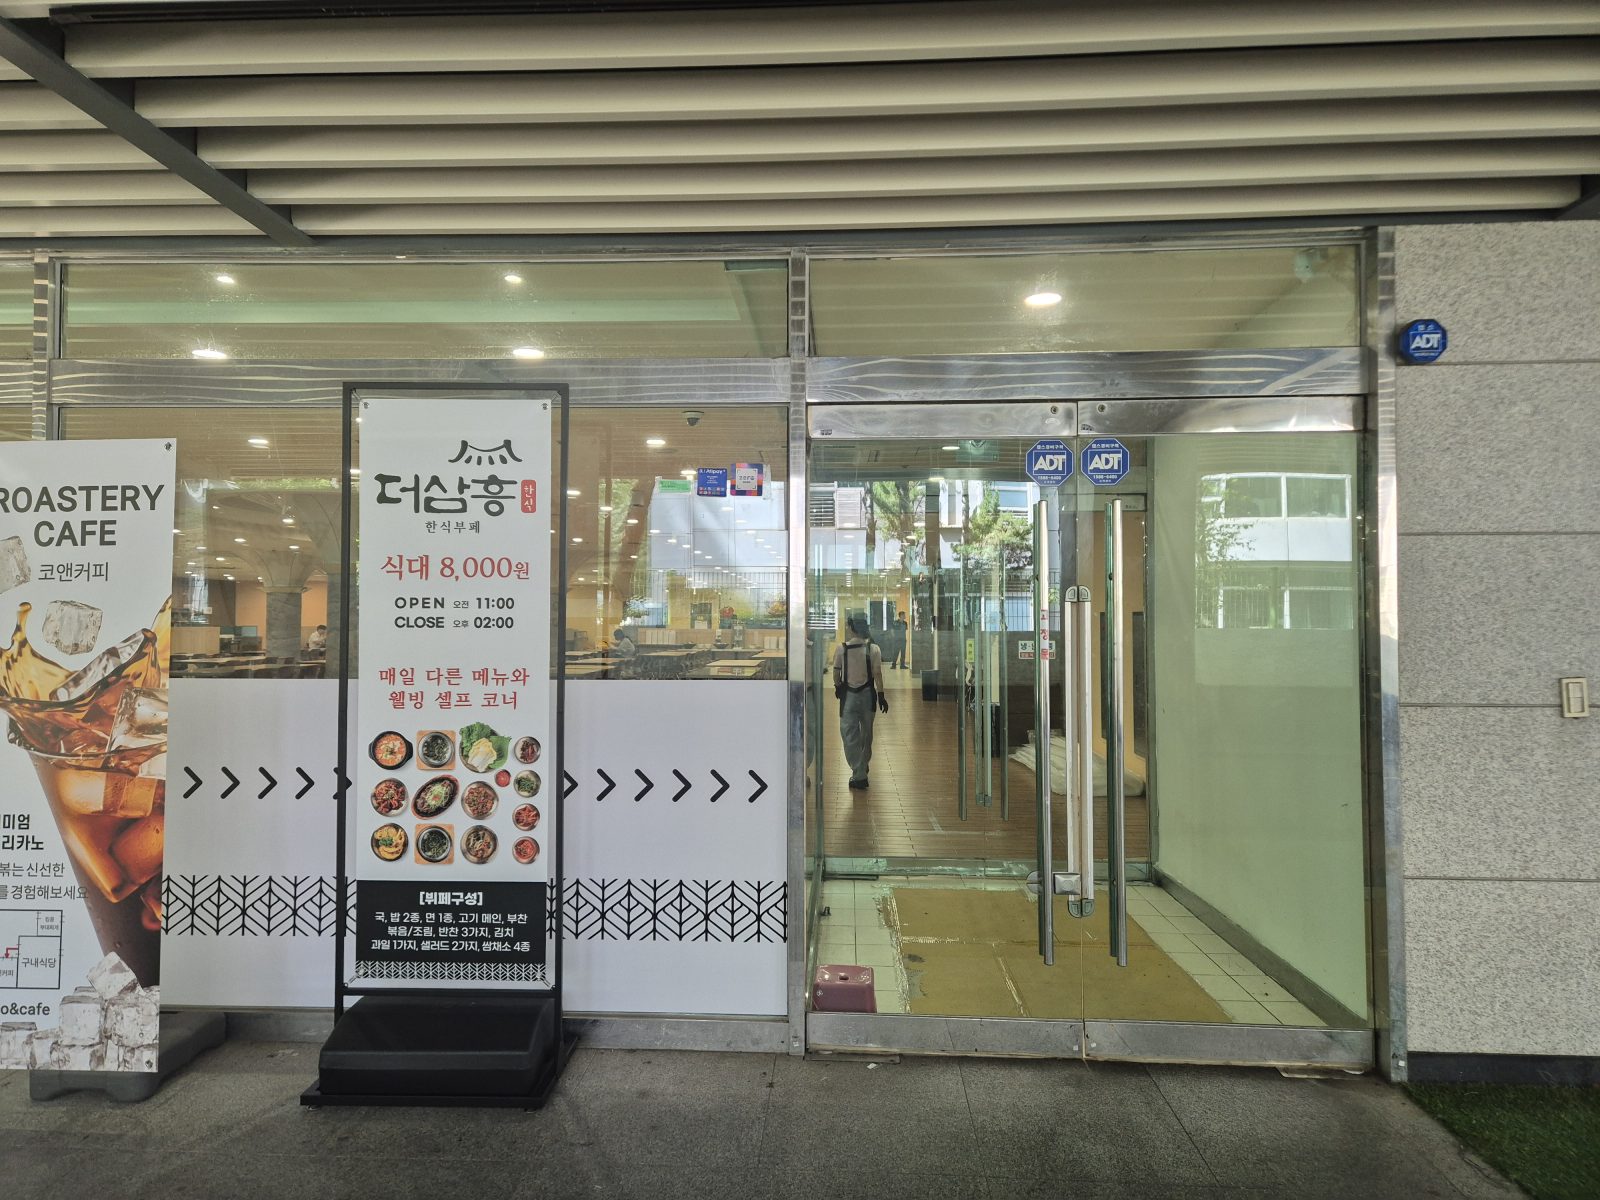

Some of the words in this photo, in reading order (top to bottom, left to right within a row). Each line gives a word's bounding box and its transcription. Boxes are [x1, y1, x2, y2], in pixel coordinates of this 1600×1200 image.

[1410, 334, 1441, 349] ADT
[1033, 454, 1066, 471] ADT
[1088, 453, 1122, 470] ADT
[374, 474, 518, 517] 더삼흥
[524, 484, 534, 512] 한식
[34, 520, 117, 547] CAFE
[425, 520, 480, 534] 한식부페
[38, 561, 109, 582] 코앤커피
[381, 554, 430, 581] 식대
[440, 556, 530, 582] 8,000원
[394, 596, 445, 610] OPEN
[453, 600, 469, 609] 오전
[476, 597, 515, 610] 11:00
[394, 616, 445, 629] CLOSE
[453, 619, 469, 628] 오후
[473, 616, 514, 629] 02:00
[379, 667, 415, 686] 매일
[426, 667, 463, 686] 다른
[472, 667, 530, 687] 메뉴와
[388, 690, 424, 710] 웰빙
[435, 690, 473, 710] 셀프
[481, 691, 517, 710] 코너
[0, 814, 31, 830] 미엄
[26, 862, 65, 877] 신선한
[11, 884, 89, 900] 경험해보세요
[374, 912, 388, 924] 국,
[391, 912, 401, 924] 밥
[403, 912, 423, 925] 2종,
[425, 913, 436, 924] 면
[438, 913, 456, 925] 1종,
[458, 913, 478, 925] 고기
[481, 913, 504, 926] 메인,
[506, 914, 528, 925] 부찬
[387, 926, 436, 938] 볶음/조림,
[438, 927, 459, 938] 반찬
[461, 927, 491, 939] 3가지,
[494, 927, 514, 939] 김치
[371, 940, 391, 950] 과일
[392, 940, 419, 951] 1가지,
[420, 940, 450, 951] 샐러드
[451, 941, 480, 952] 2가지,
[481, 942, 512, 952] 쌈채소
[513, 942, 531, 952] 4종
[21, 957, 57, 968] 구내식당
[0, 1002, 51, 1016] o&cafe
